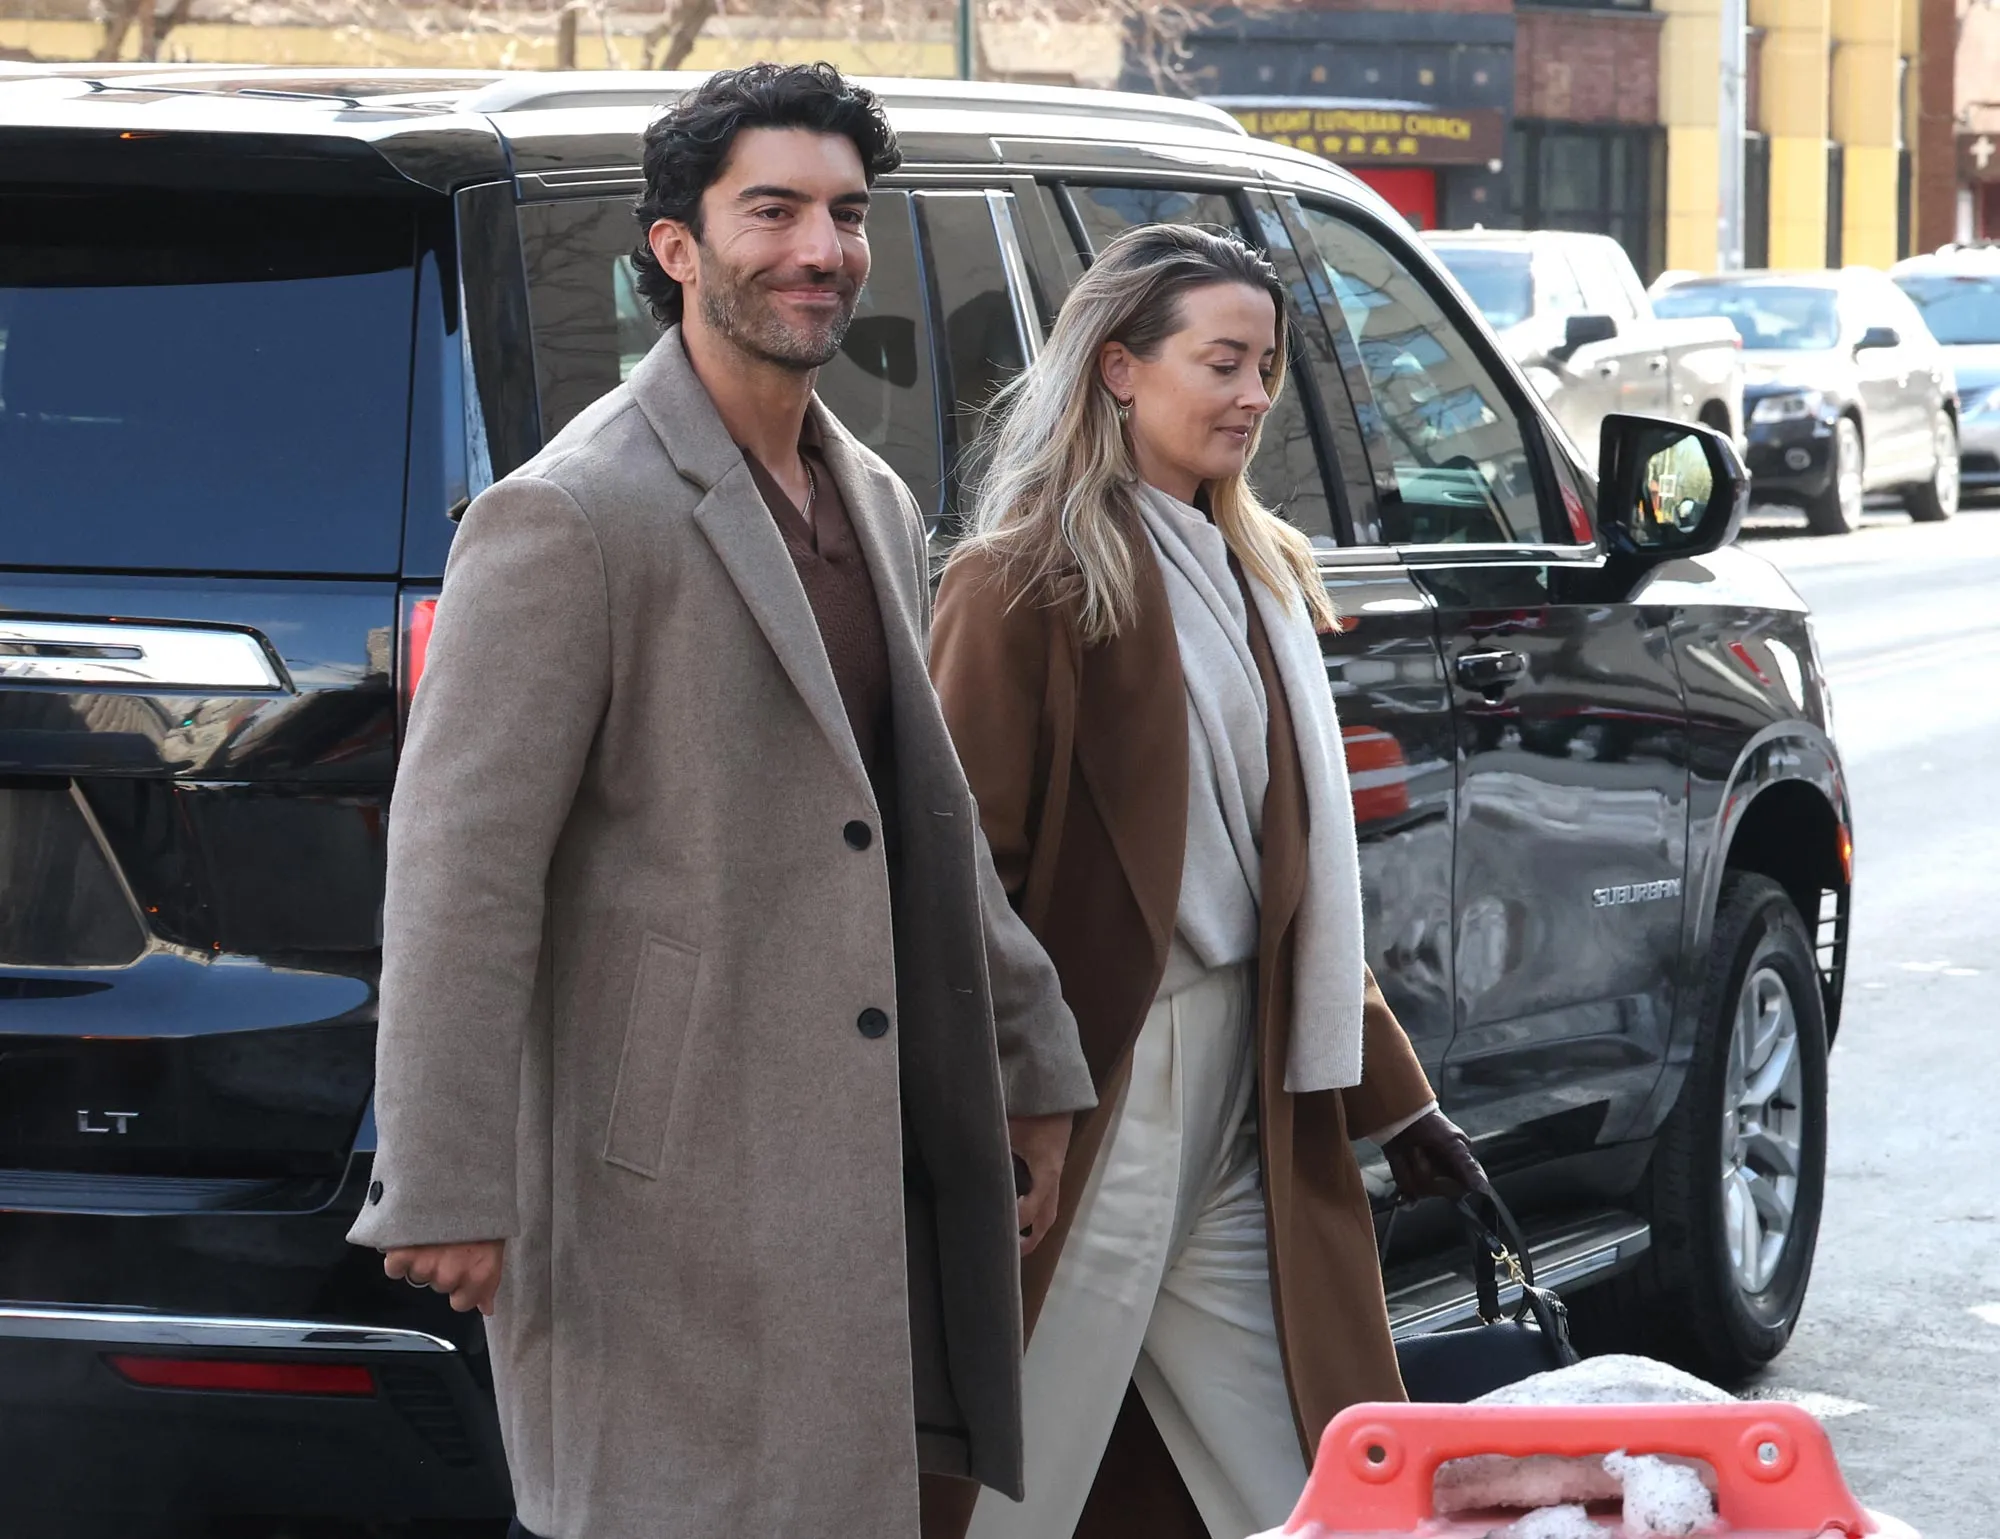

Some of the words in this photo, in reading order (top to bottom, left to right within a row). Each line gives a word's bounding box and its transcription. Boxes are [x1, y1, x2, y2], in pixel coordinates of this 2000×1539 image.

[1261, 110, 1311, 132] LIGHT
[1405, 114, 1471, 140] CHURCH
[1592, 878, 1681, 907] SUBURBAN
[77, 1109, 139, 1134] LT
